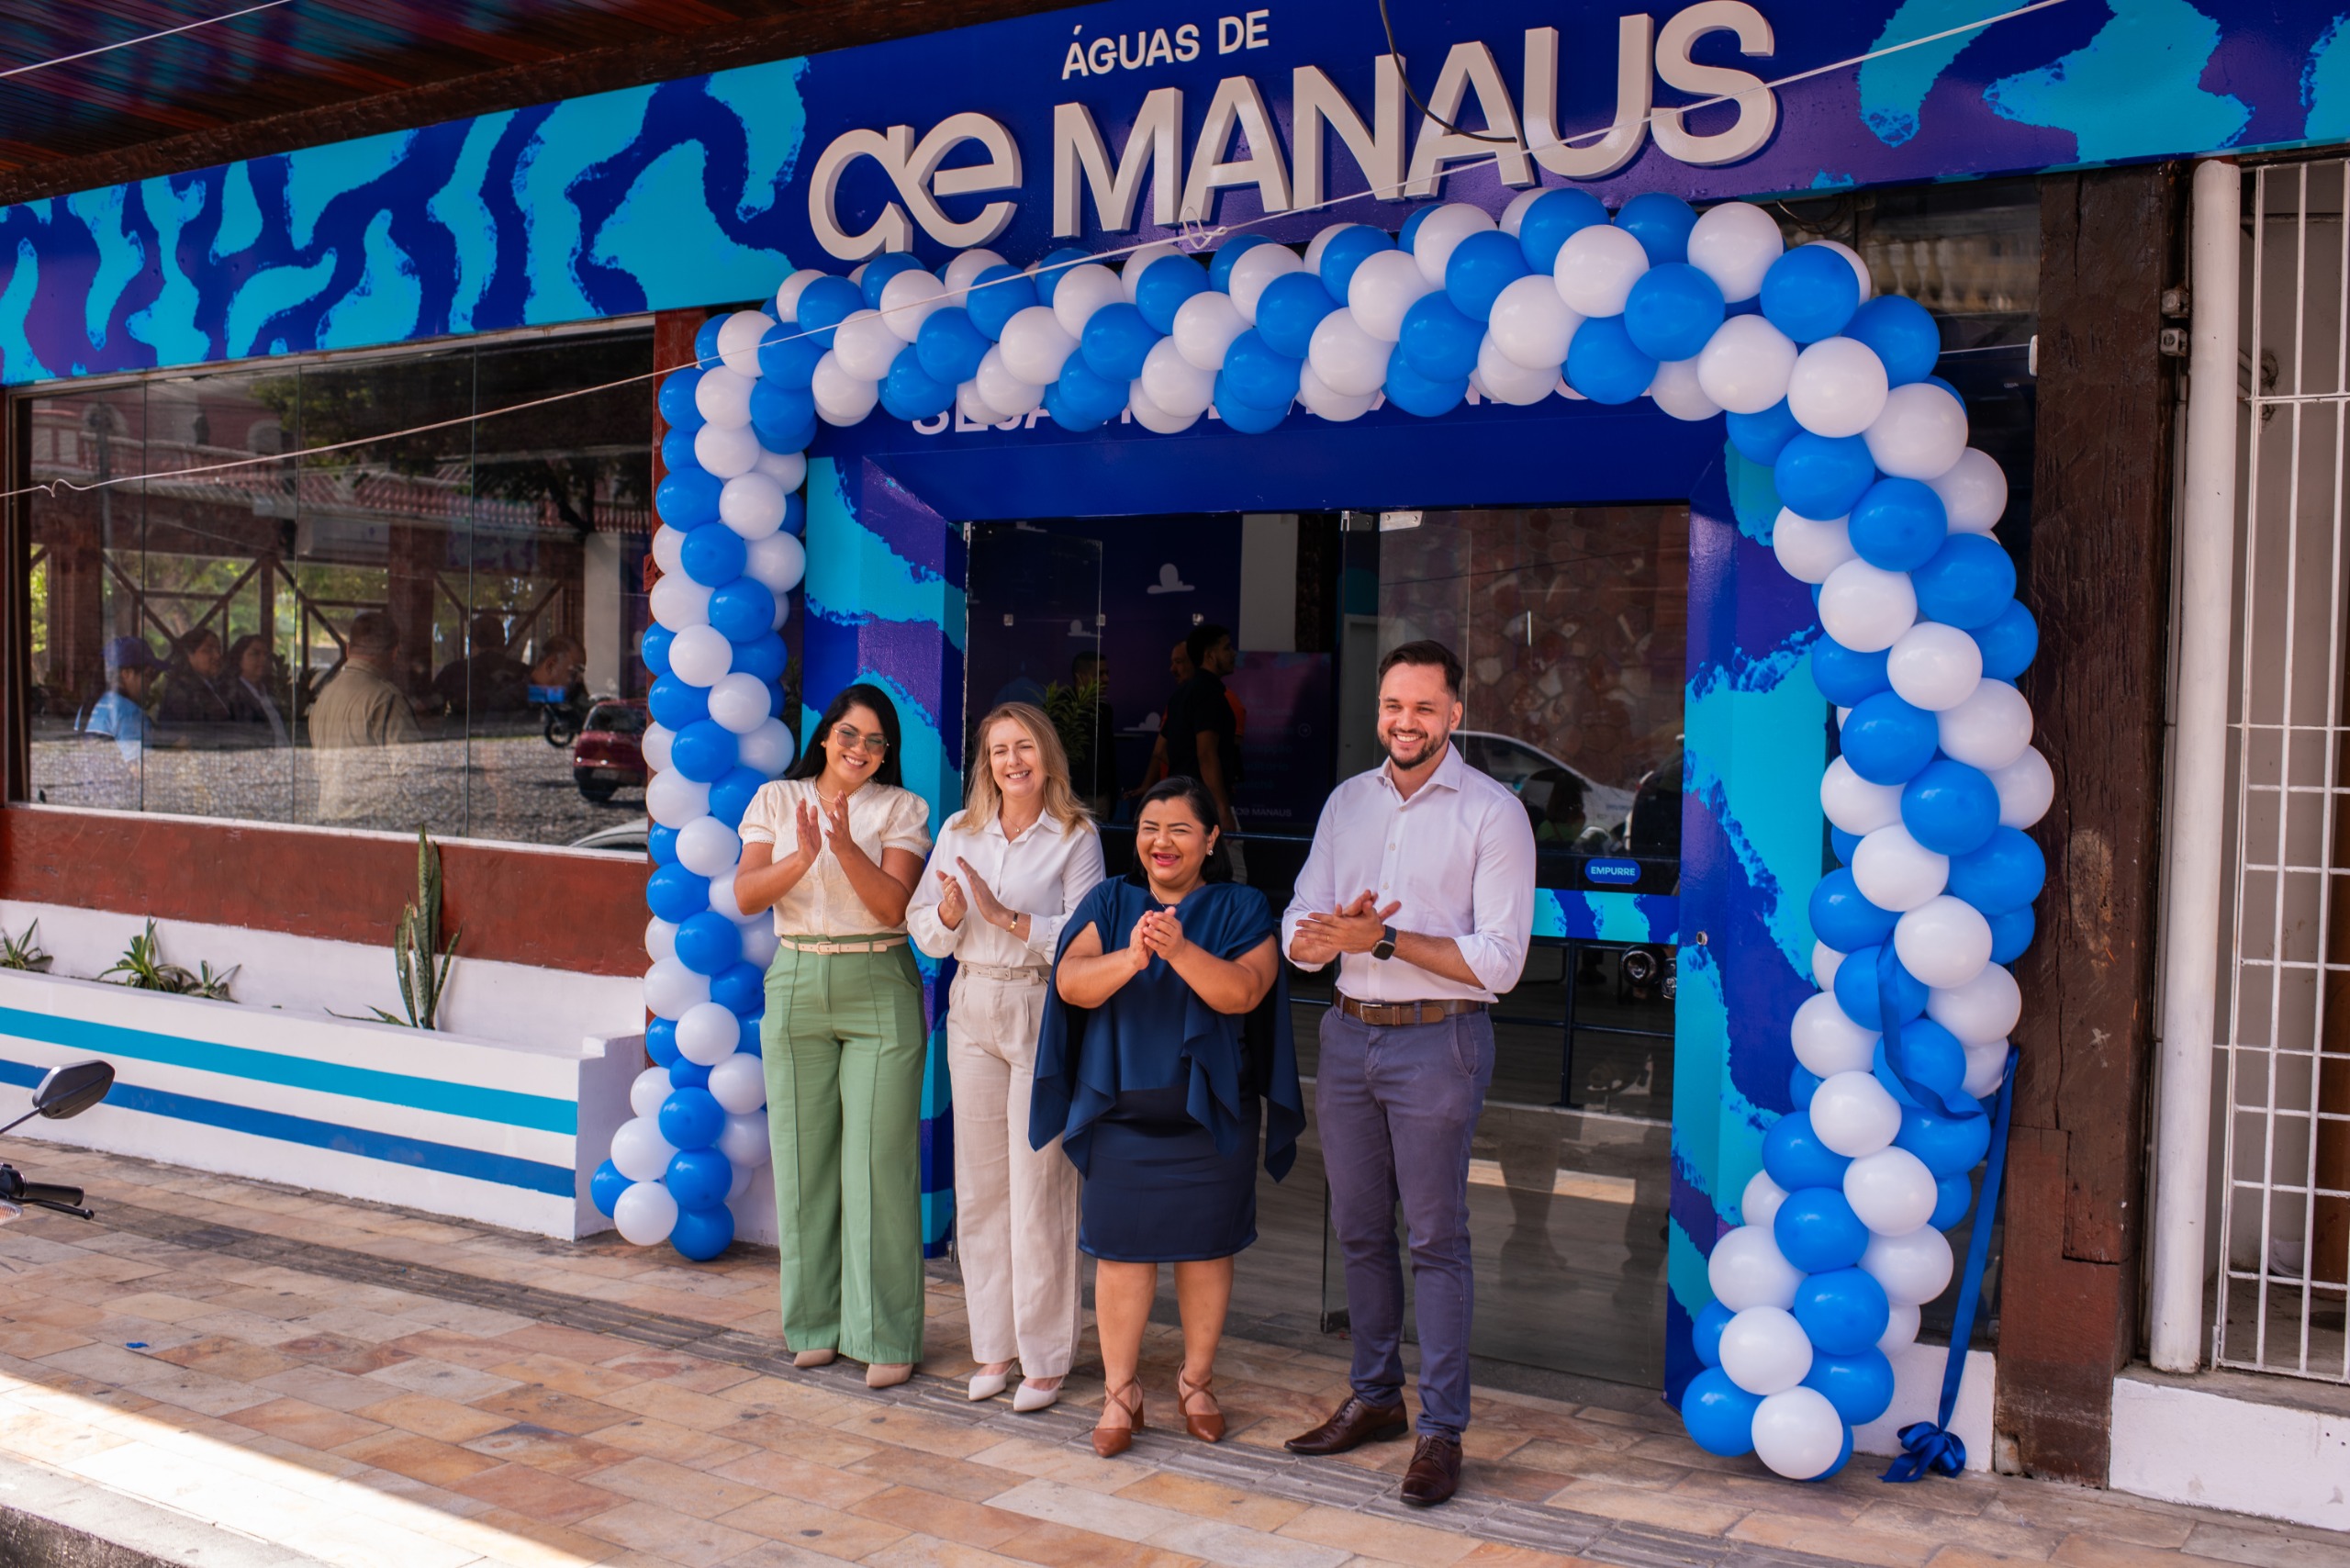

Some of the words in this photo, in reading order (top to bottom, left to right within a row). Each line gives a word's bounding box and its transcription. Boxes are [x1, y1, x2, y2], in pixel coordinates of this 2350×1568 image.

[1061, 22, 1201, 81] ÁGUAS
[1215, 8, 1270, 53] DE
[1052, 0, 1778, 238] MANAUS
[1251, 808, 1292, 817] MANAUS
[1591, 867, 1635, 876] EMPURRE
